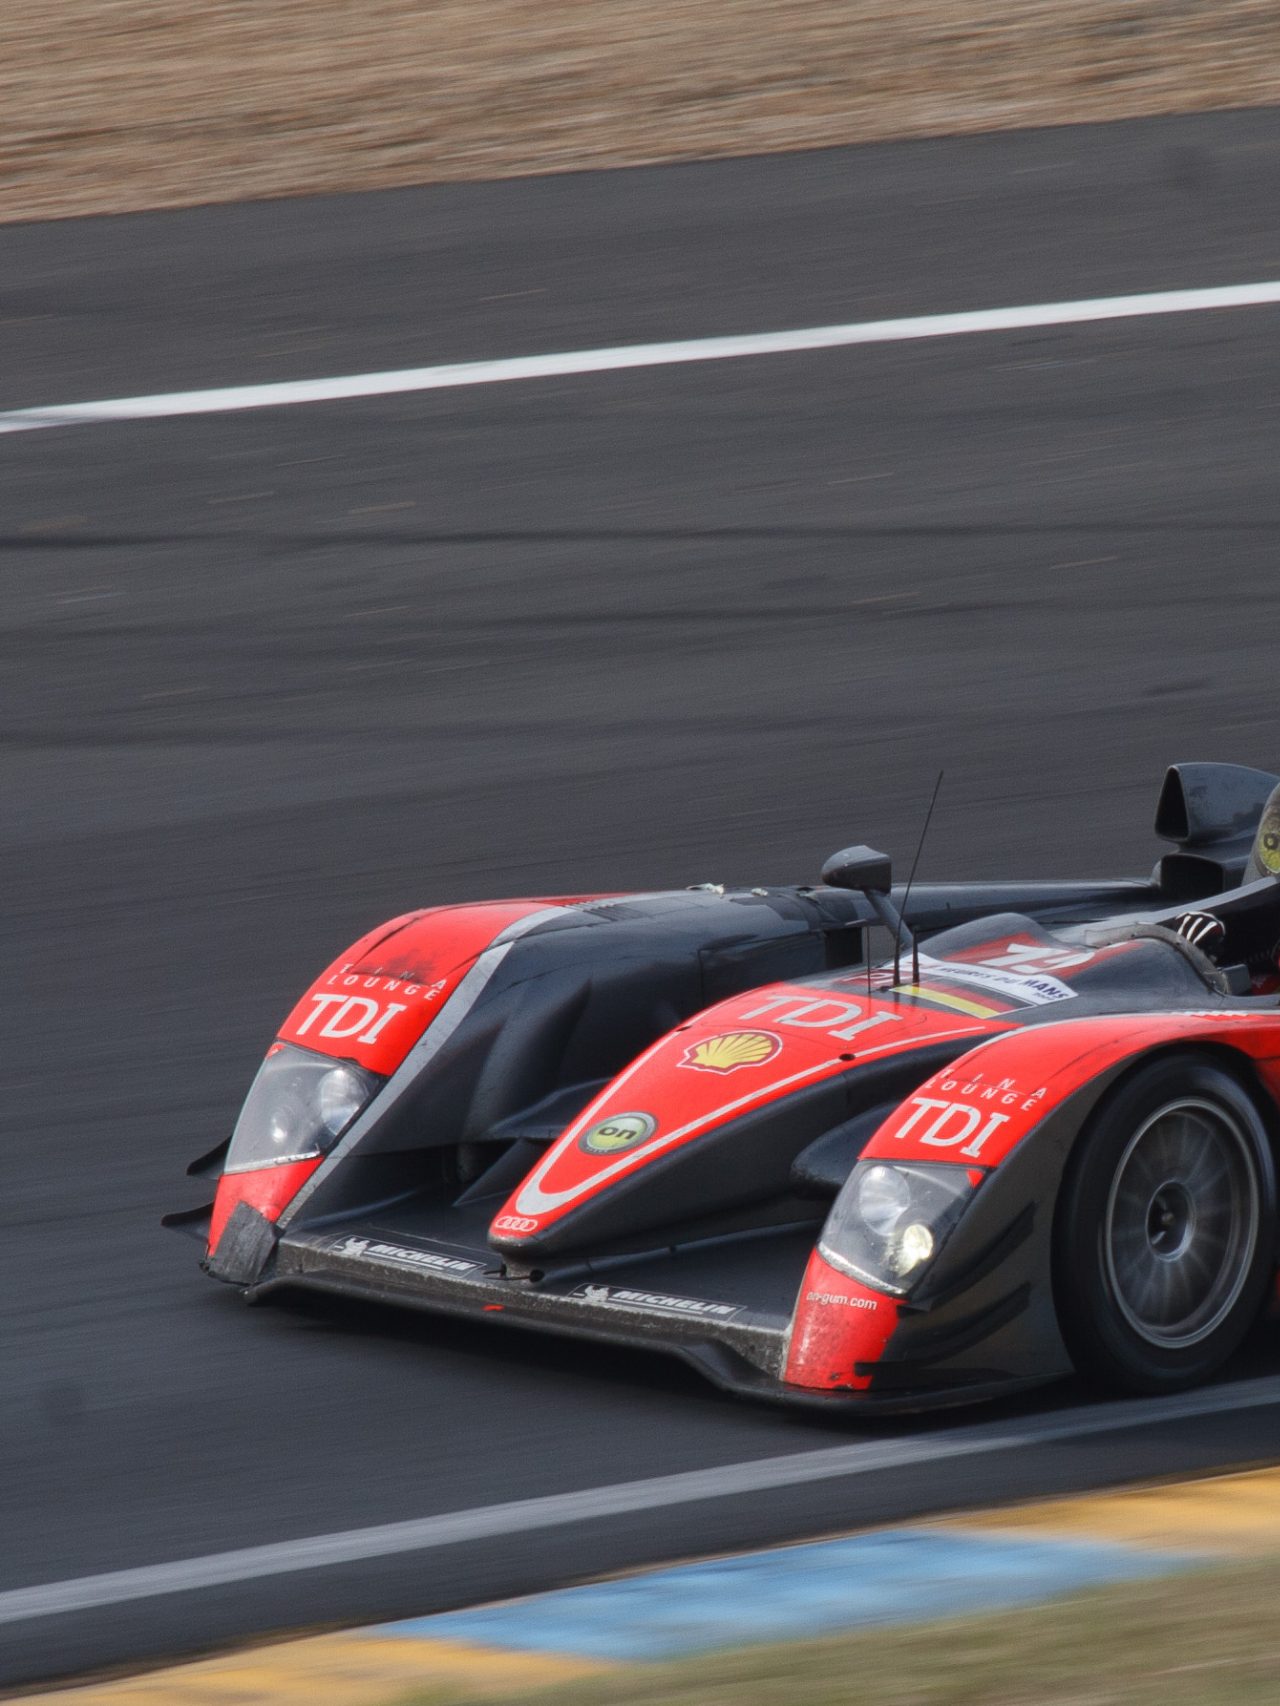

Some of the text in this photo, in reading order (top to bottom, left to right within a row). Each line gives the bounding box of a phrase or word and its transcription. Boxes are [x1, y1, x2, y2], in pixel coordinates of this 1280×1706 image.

[326, 974, 441, 1001] LOUNGE
[1021, 978, 1070, 1000] MANS
[295, 993, 408, 1045] TDI
[738, 995, 904, 1041] TDI
[924, 1078, 1038, 1112] LOUNGE
[940, 1068, 1048, 1100] TINA
[598, 1126, 638, 1140] on
[894, 1096, 1011, 1159] TDI
[368, 1243, 478, 1272] MICHELIN
[611, 1289, 738, 1315] MICHELIN
[805, 1291, 879, 1311] on-gum.com
